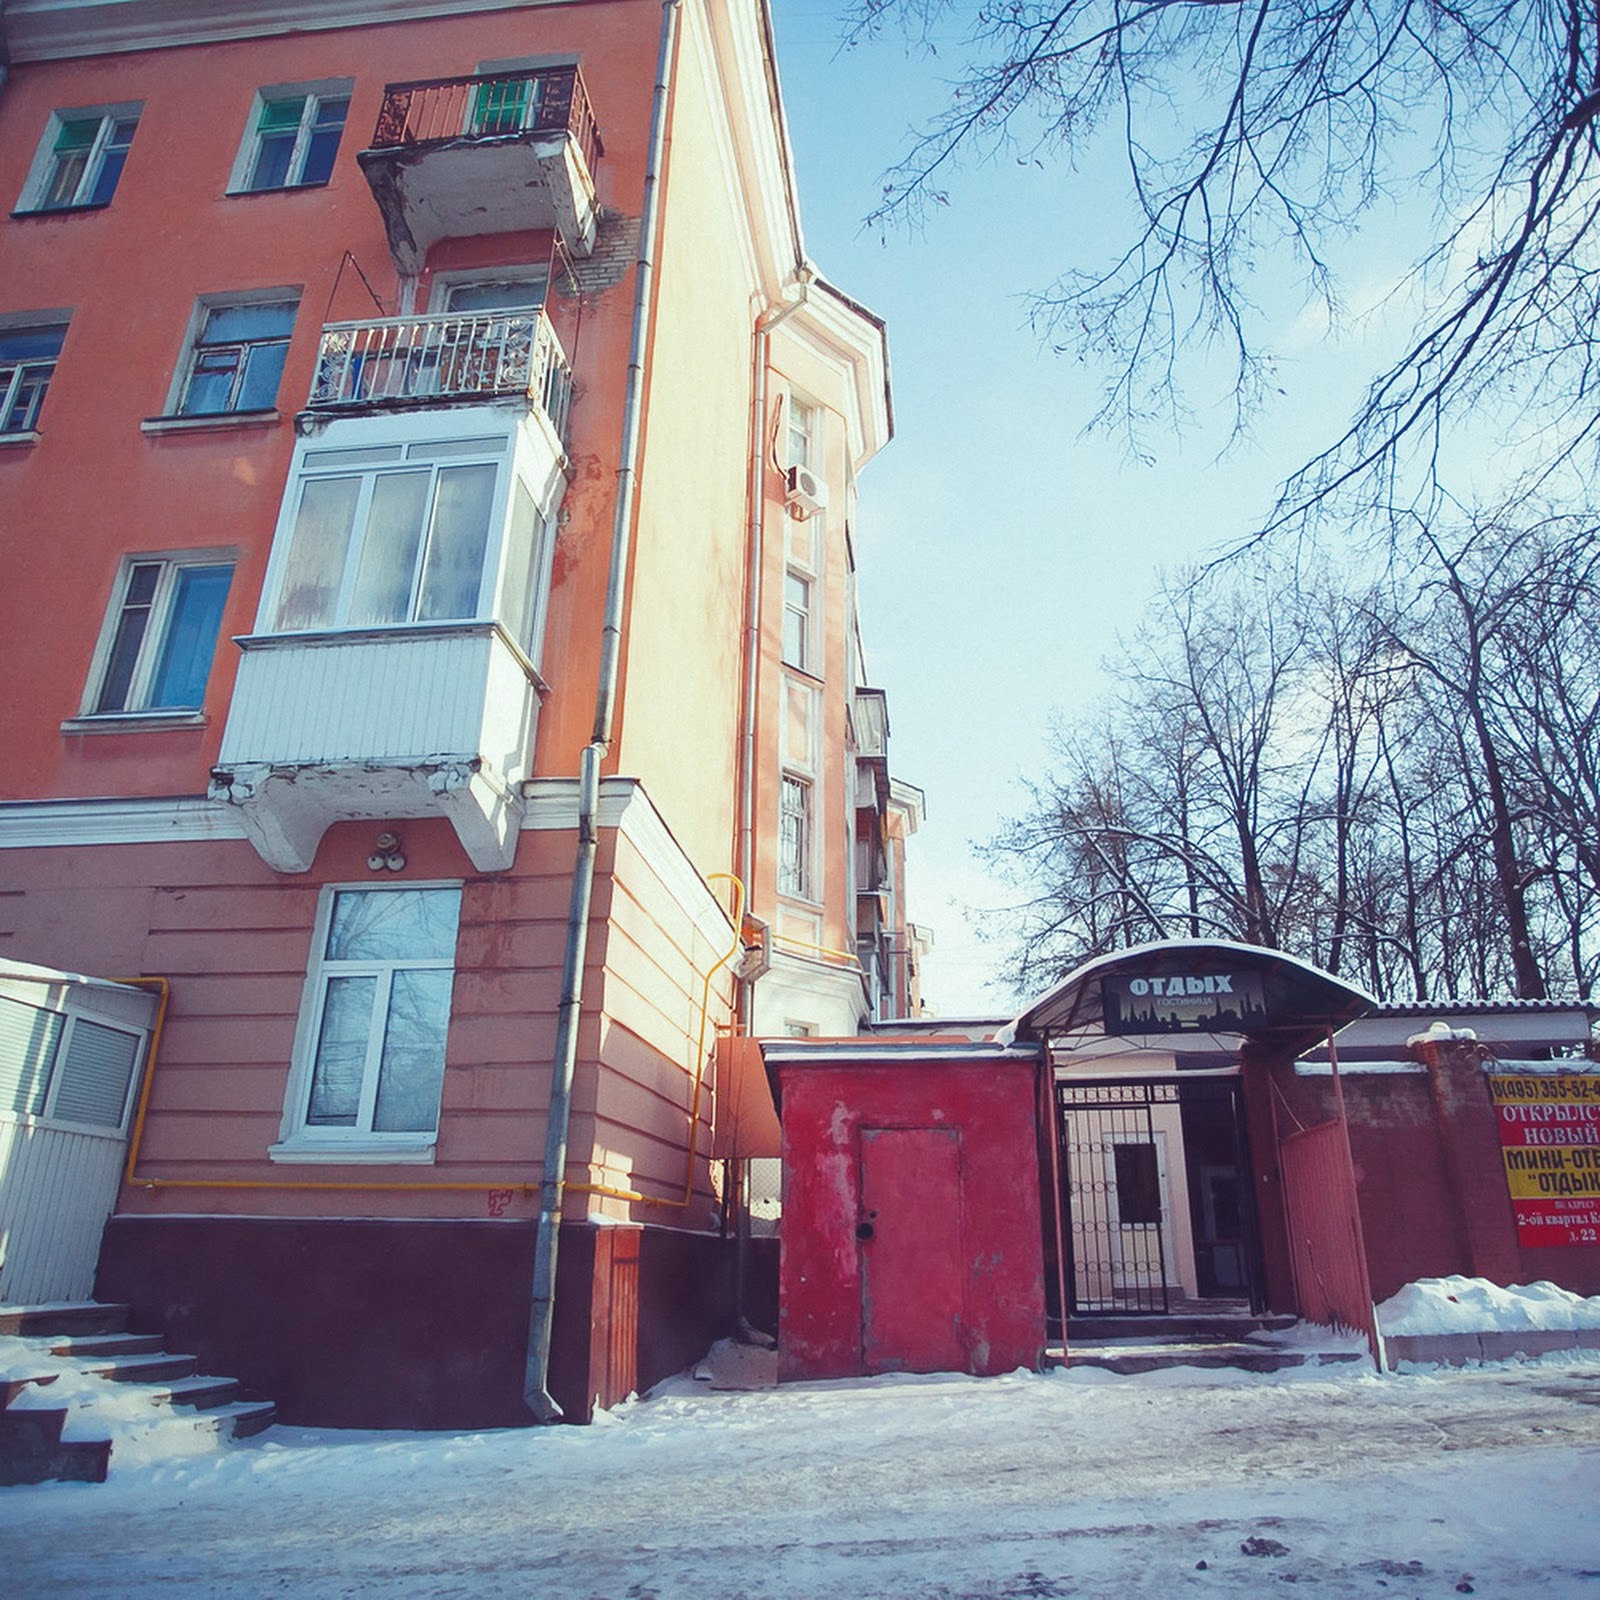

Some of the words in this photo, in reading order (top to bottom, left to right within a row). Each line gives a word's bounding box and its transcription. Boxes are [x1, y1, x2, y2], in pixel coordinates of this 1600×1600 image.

[1129, 975, 1234, 996] ОТДЫХ
[1157, 997, 1213, 1007] ГОСТИНИЦА
[1492, 1080, 1538, 1098] 8(495)
[1503, 1105, 1600, 1122] ОТКРЫЛС
[1524, 1123, 1599, 1144] НОВЫЙ
[1581, 1228, 1598, 1240] 22
